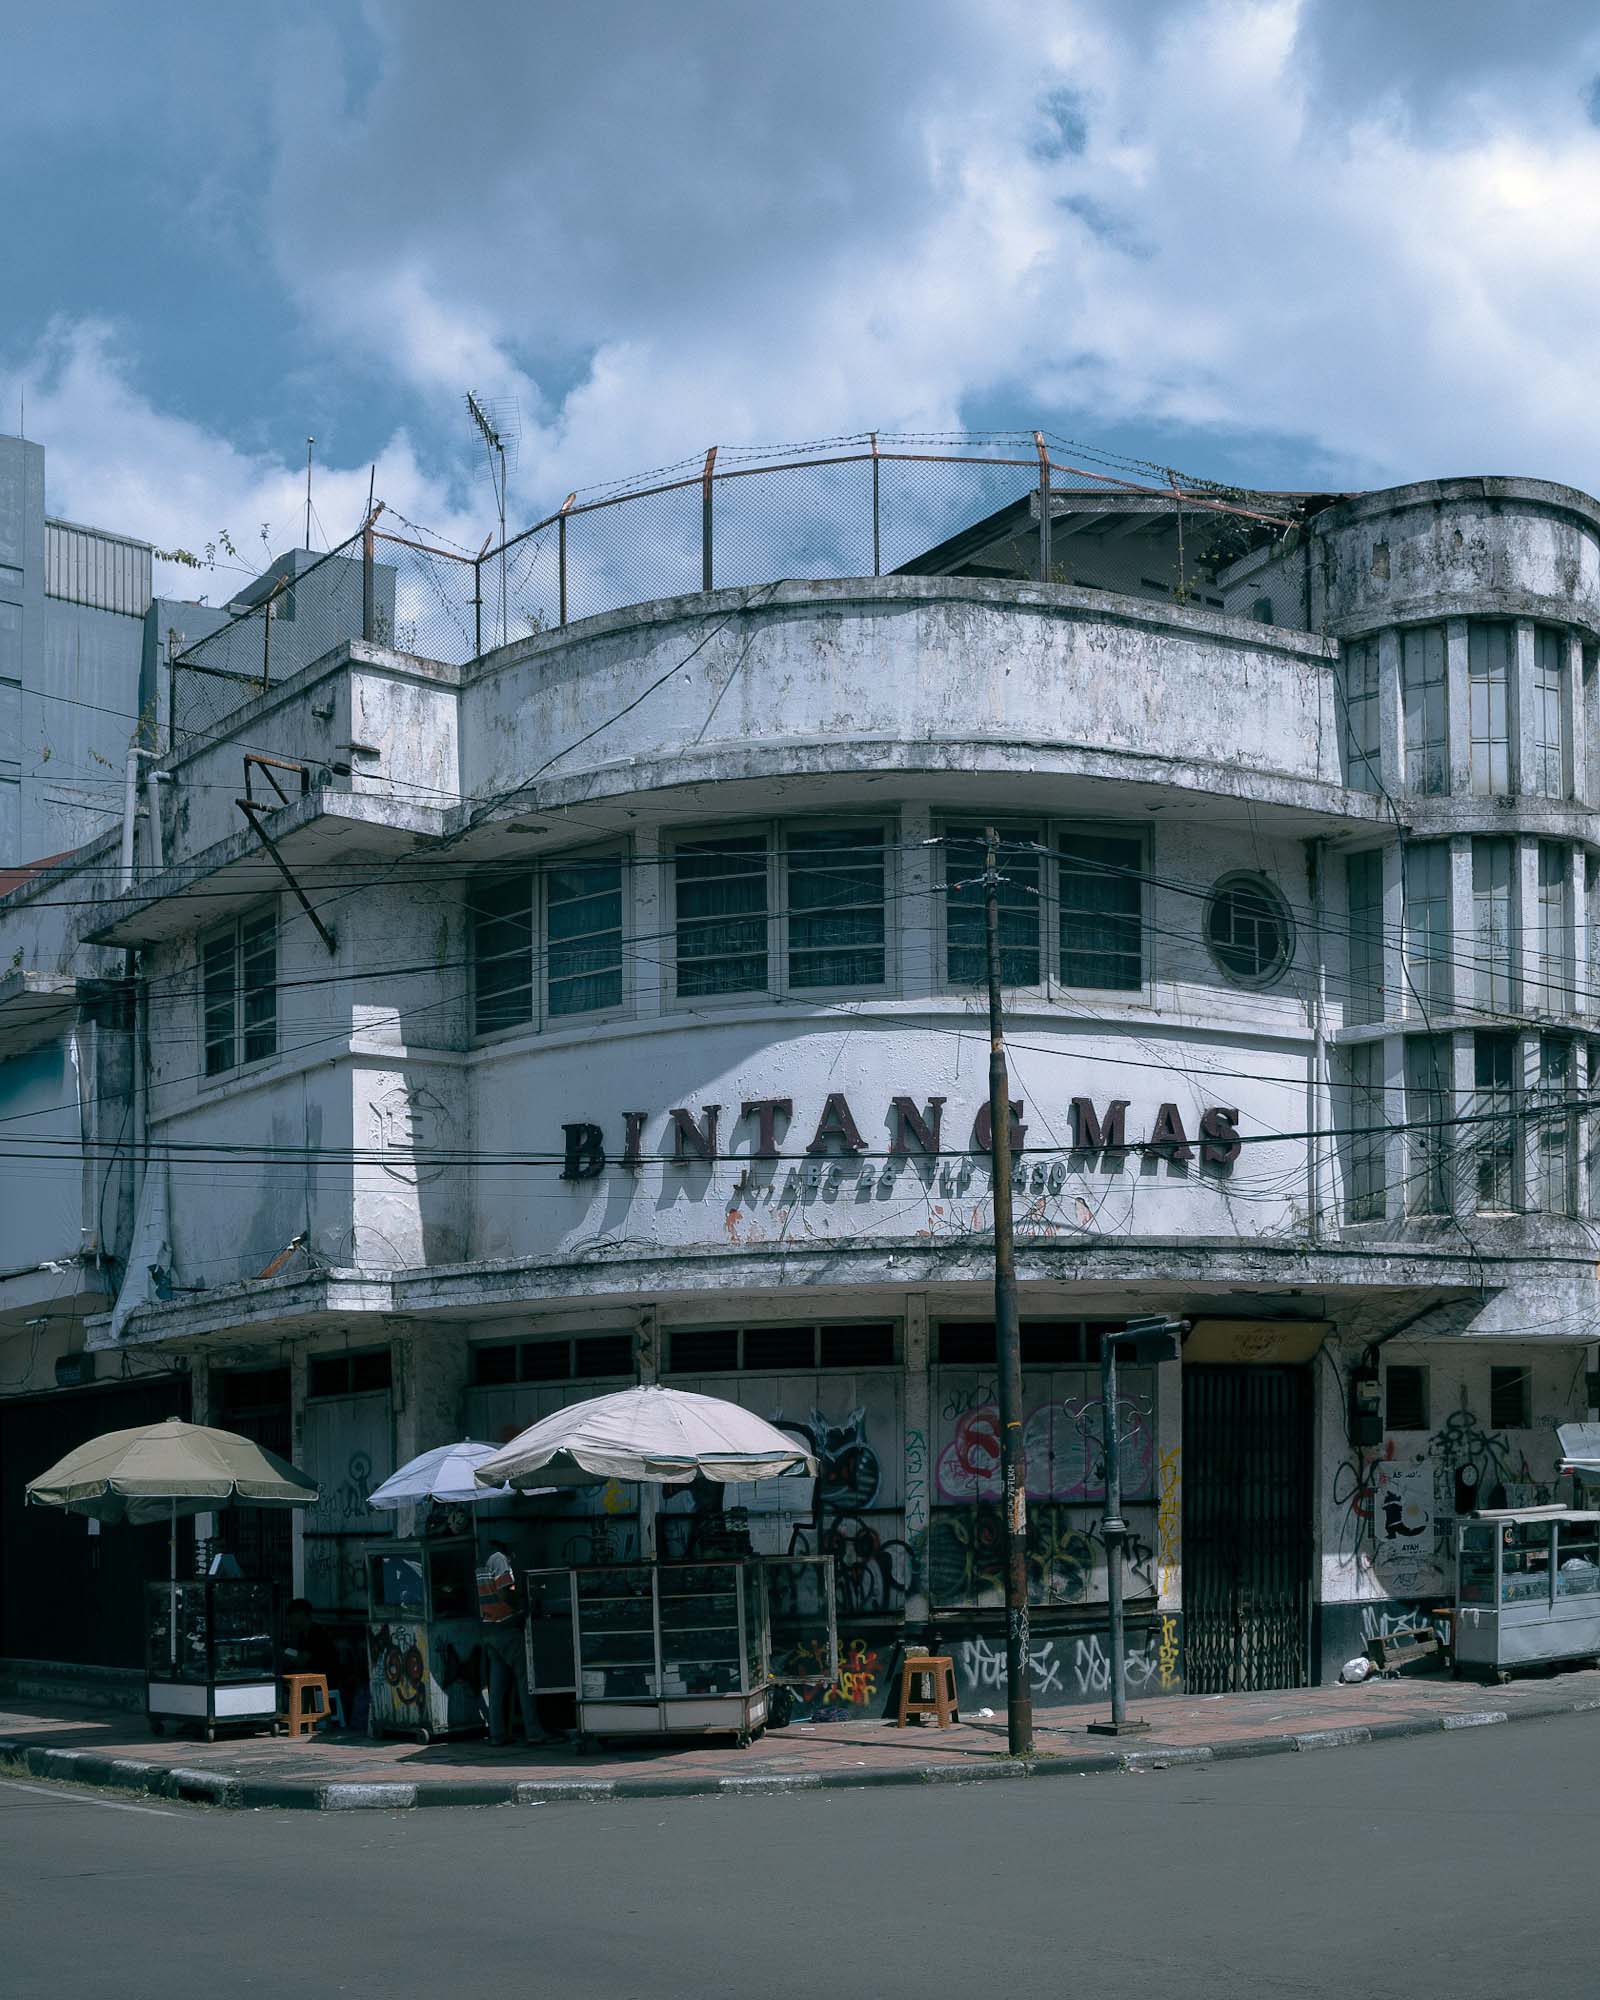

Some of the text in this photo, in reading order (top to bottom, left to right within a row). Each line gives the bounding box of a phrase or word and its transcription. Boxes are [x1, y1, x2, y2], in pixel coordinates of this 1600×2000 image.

[559, 1093, 1242, 1179] BINTANG MAS
[785, 1164, 843, 1189] ABC
